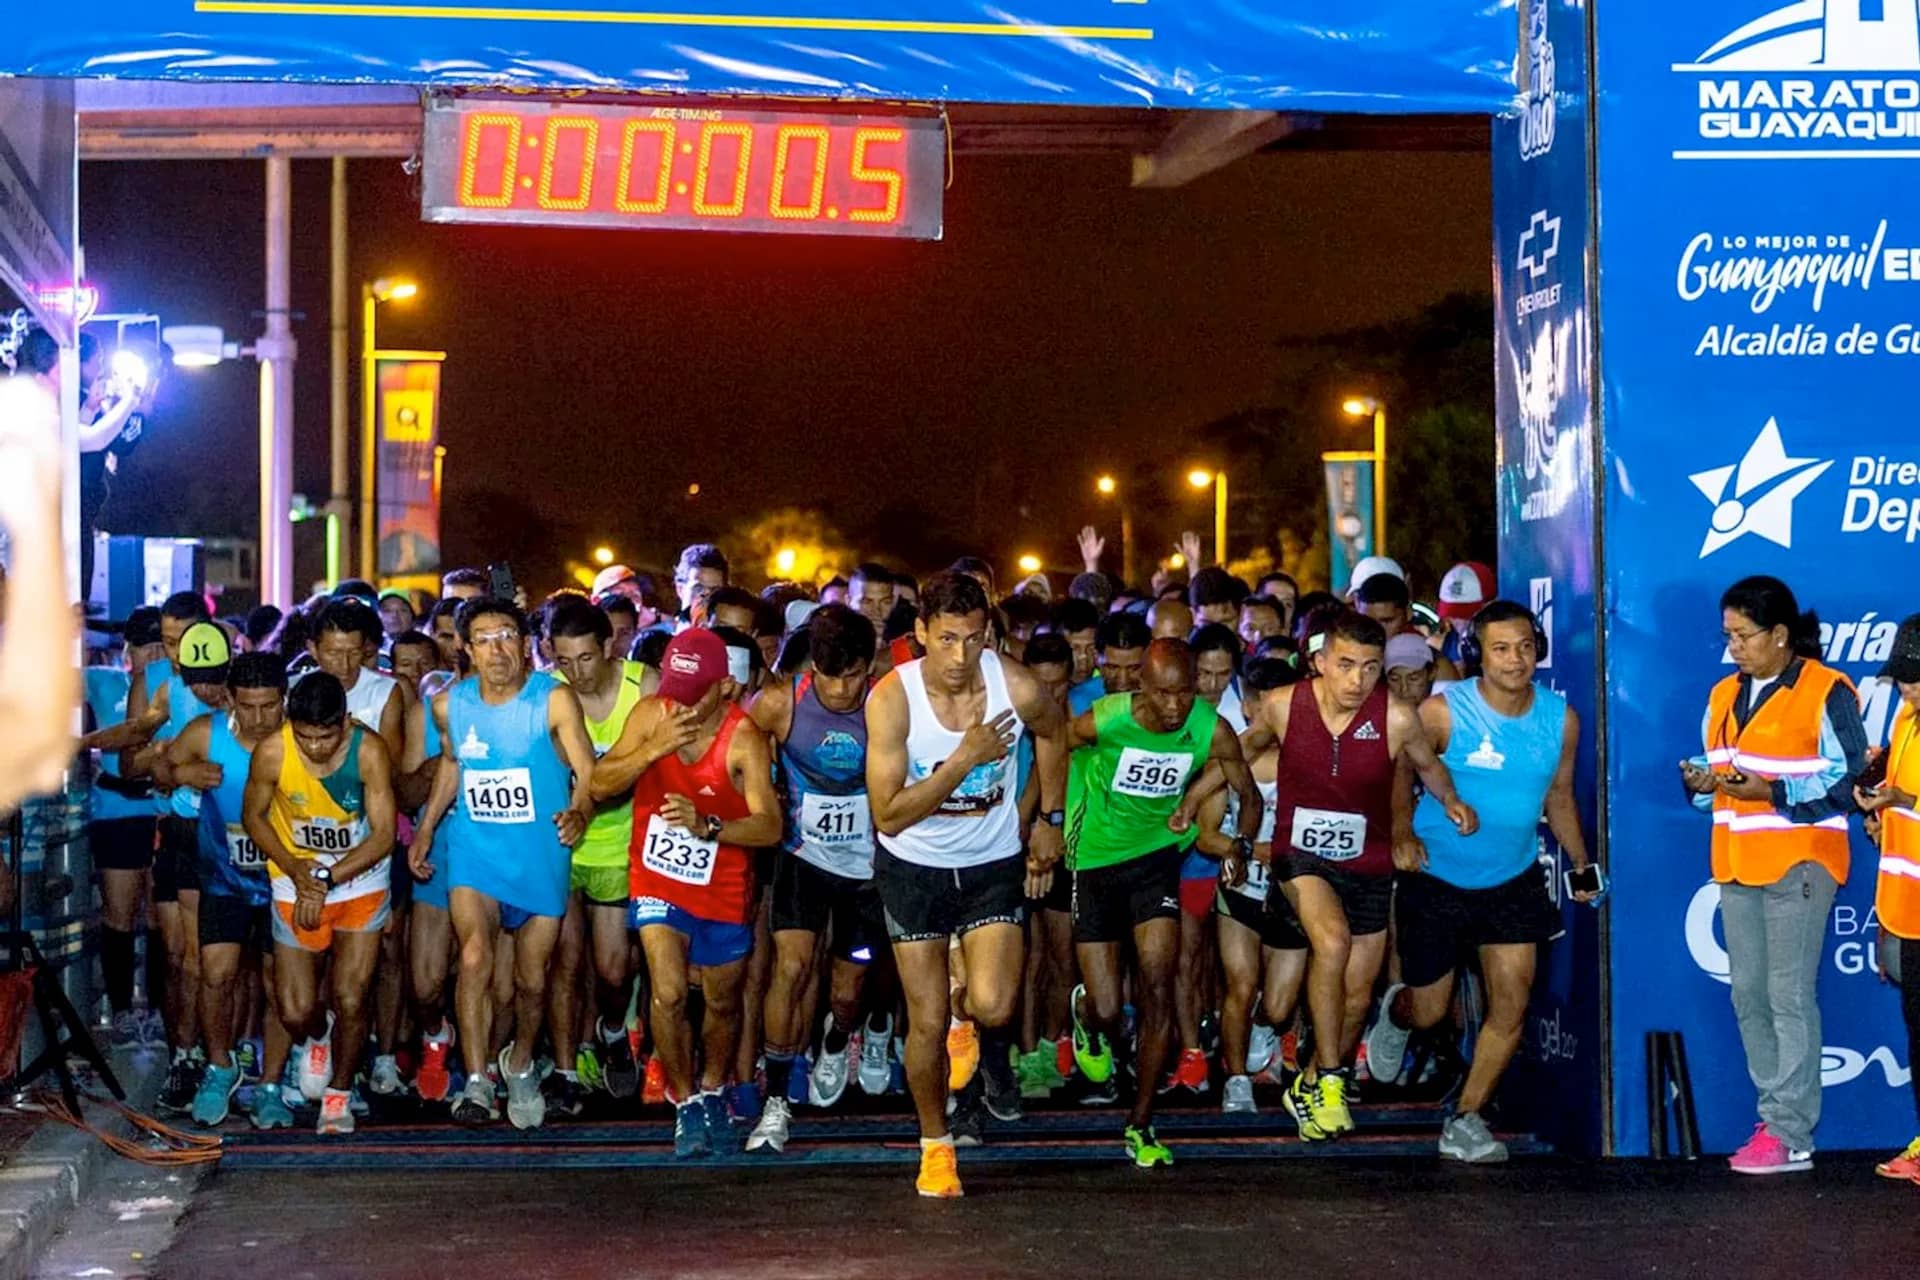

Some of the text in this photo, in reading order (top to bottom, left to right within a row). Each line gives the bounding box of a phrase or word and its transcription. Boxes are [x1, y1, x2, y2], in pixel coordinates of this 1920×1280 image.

[1699, 80, 1919, 108] MARATO
[1699, 112, 1920, 140] GUAYAQUI
[1723, 235, 1850, 252] LO MEJOR DE
[1677, 218, 1888, 314] Guayaquil
[1695, 323, 1828, 356] Alcaldía
[1835, 323, 1878, 355] de
[1849, 456, 1920, 486] Dire
[1126, 764, 1179, 786] 596
[468, 786, 529, 809] 1409
[816, 812, 855, 833] 411
[301, 825, 351, 849] 1580
[1302, 828, 1355, 850] 625
[649, 833, 711, 869] 1233
